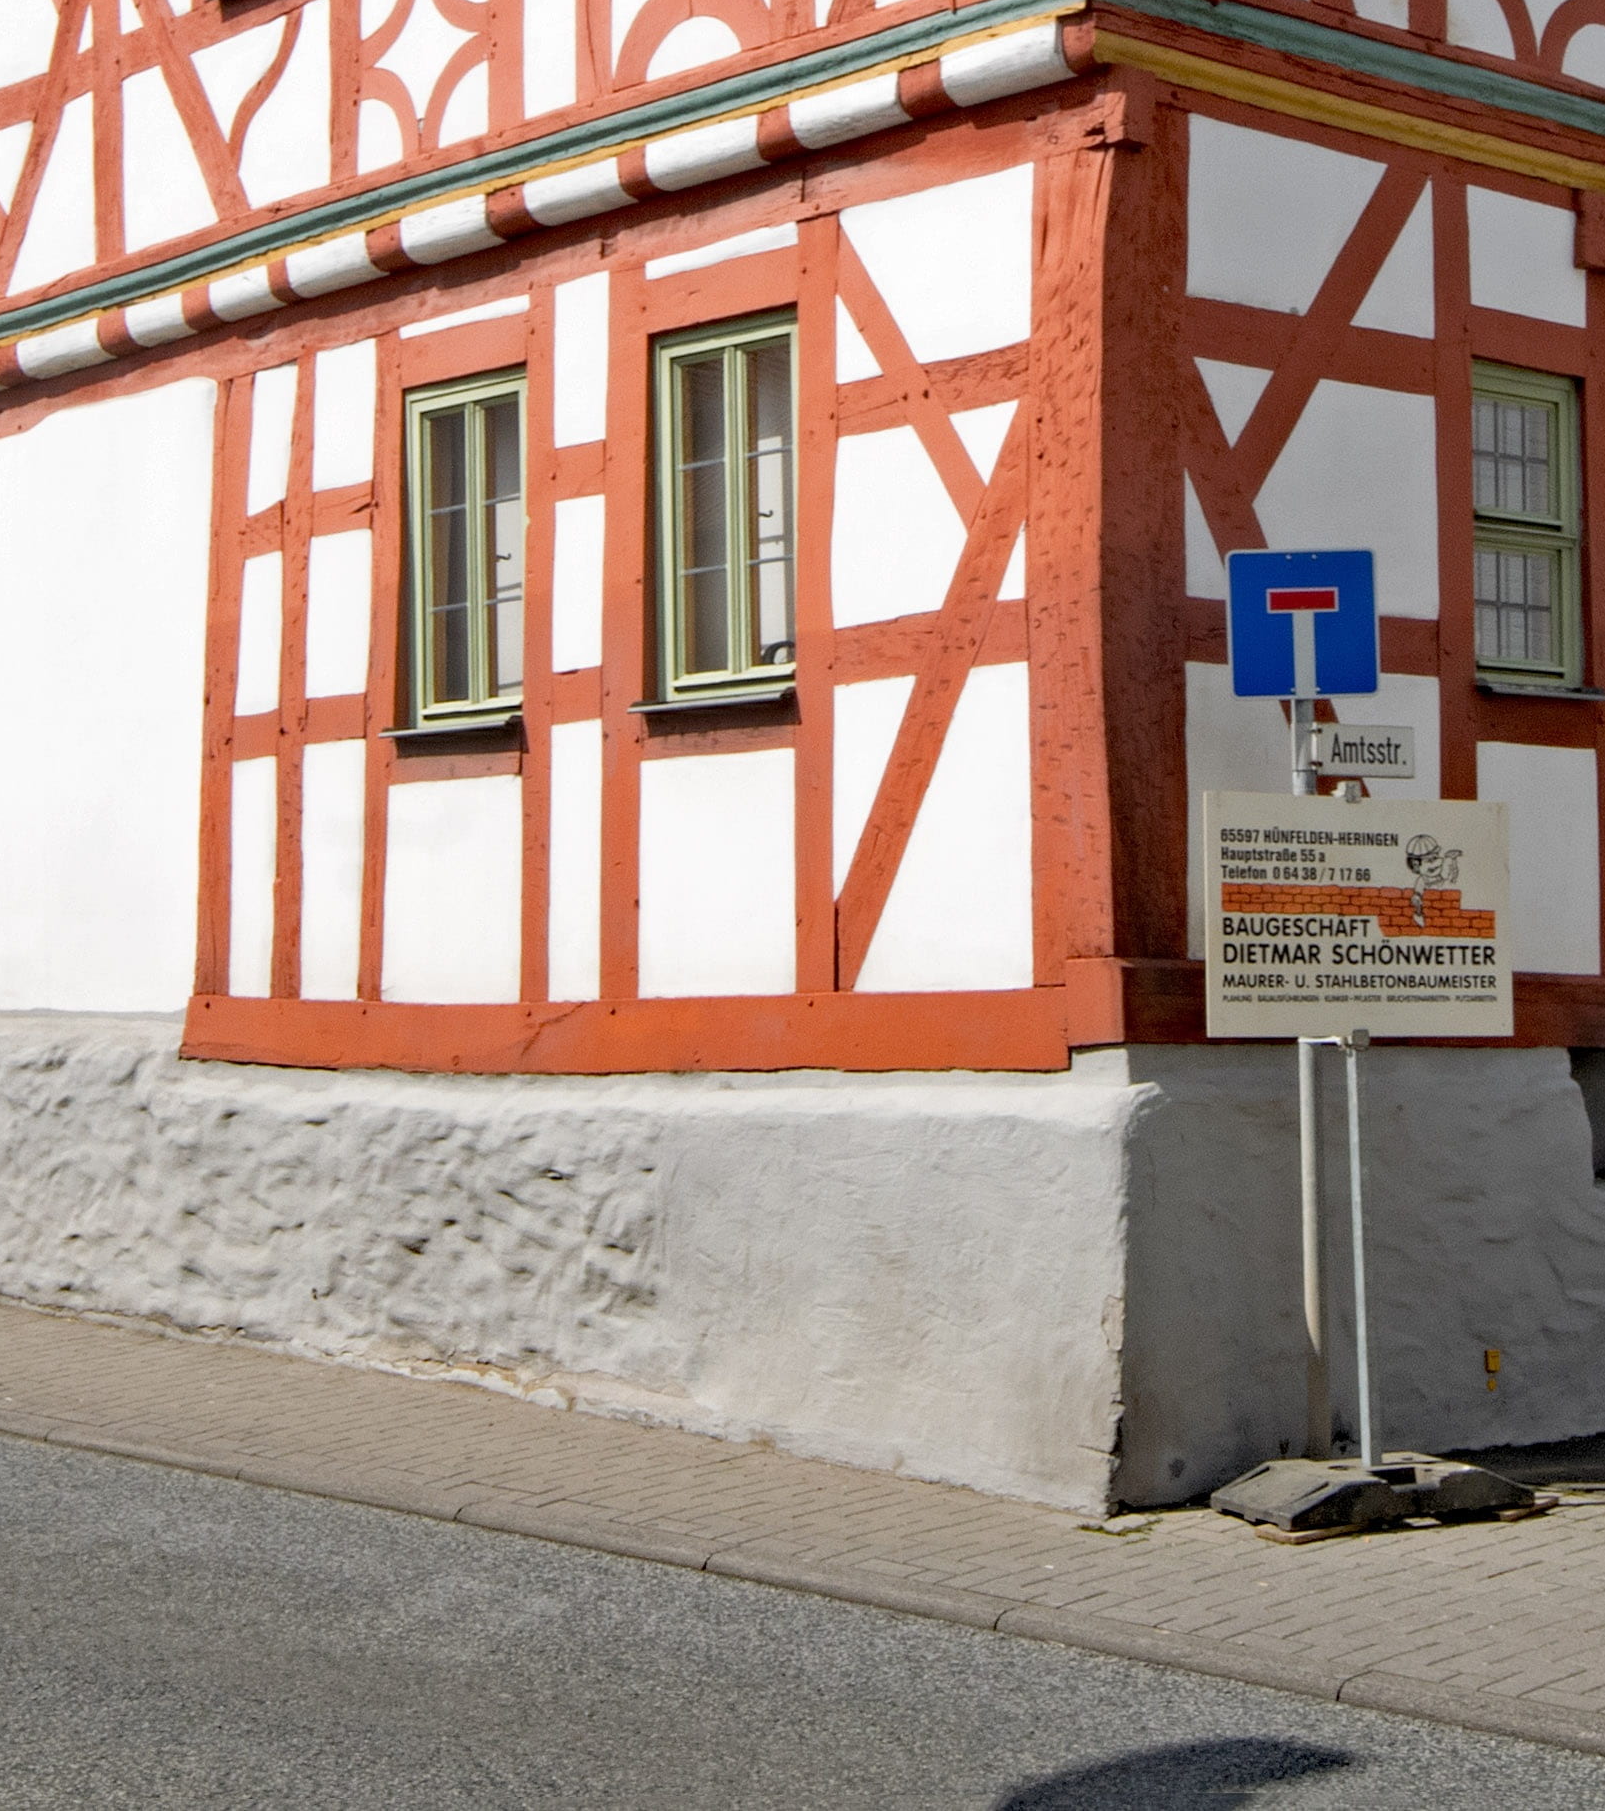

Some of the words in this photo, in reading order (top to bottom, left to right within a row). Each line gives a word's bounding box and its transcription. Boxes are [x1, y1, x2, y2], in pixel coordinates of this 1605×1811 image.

[1331, 732, 1407, 765] Amtsstr.
[1221, 828, 1260, 844] 65597
[1263, 826, 1399, 847] HÜNFELDEN-HERINGEN
[1221, 847, 1297, 863] Hauptstraße
[1300, 849, 1316, 862] 55
[1318, 851, 1326, 863] a
[1221, 865, 1267, 879] Telefon
[1223, 943, 1321, 964] DIETMAR
[1332, 939, 1496, 965] SCHÖNWETTER
[1223, 974, 1290, 988] MAURER-
[1295, 974, 1310, 988] U.
[1315, 974, 1497, 988] STAHLBETONBAUMEISTER
